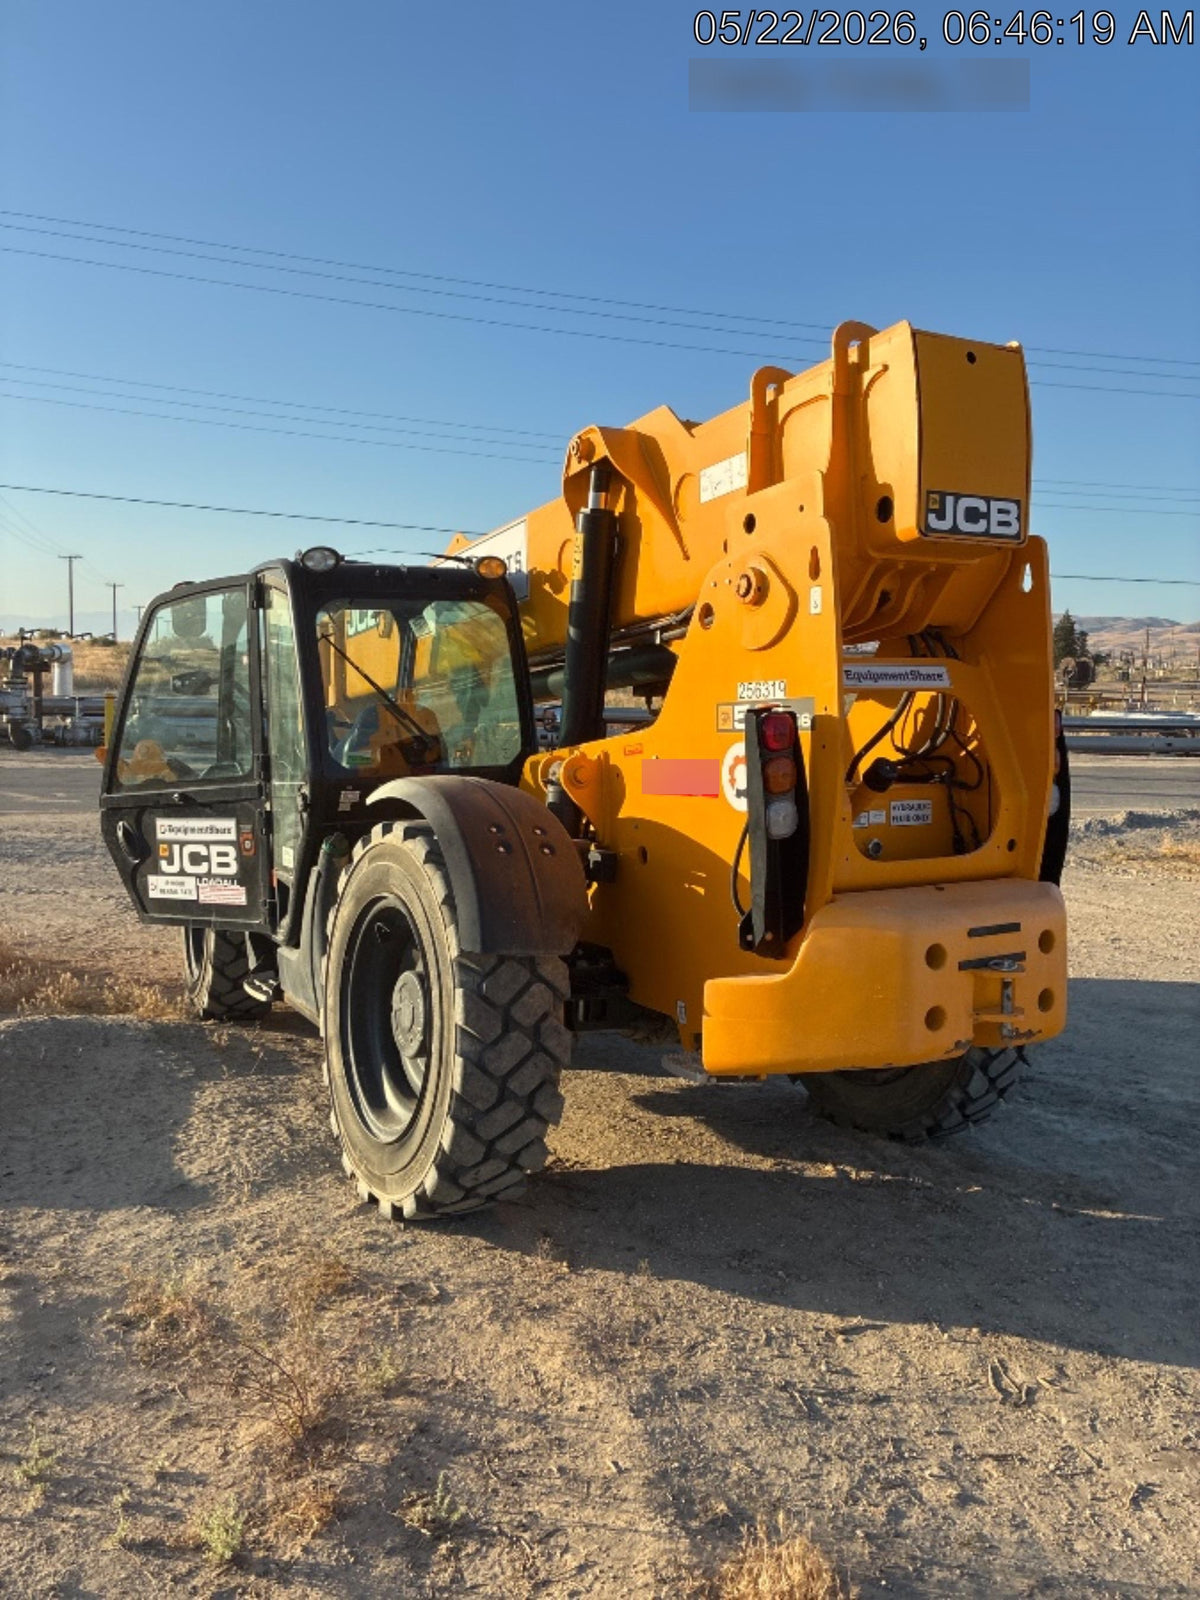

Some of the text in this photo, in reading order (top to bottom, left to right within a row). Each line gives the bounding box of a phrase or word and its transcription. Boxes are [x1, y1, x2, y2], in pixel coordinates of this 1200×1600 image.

[928, 495, 1020, 536] JCB
[844, 669, 945, 683] EquipmentShare
[738, 680, 786, 700] 256319
[159, 844, 238, 875] JCB
